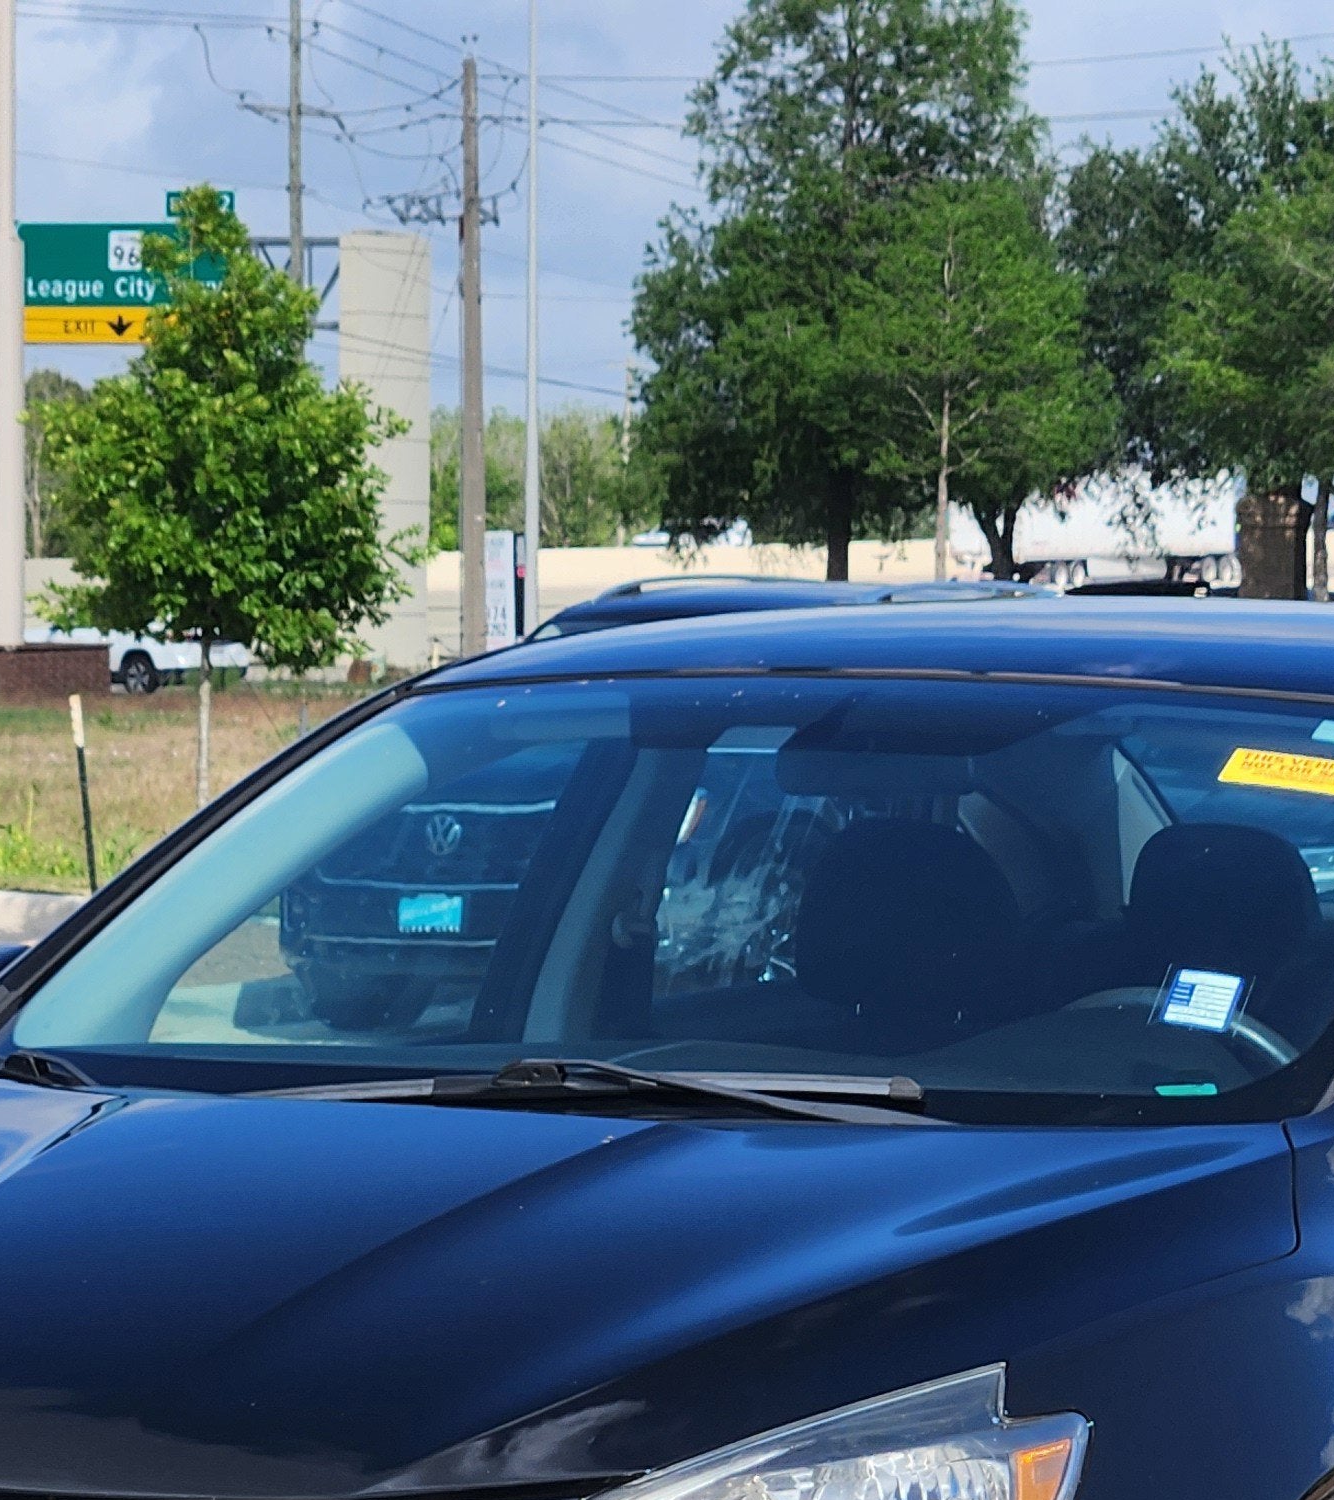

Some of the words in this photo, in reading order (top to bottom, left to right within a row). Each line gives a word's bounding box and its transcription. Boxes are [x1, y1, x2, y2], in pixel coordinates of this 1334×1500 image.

[26, 276, 104, 302] League
[114, 276, 156, 303] City
[63, 320, 95, 334] EXIT
[1244, 752, 1284, 763] THIS
[1241, 761, 1273, 770] NOT
[1280, 764, 1312, 775] FOR
